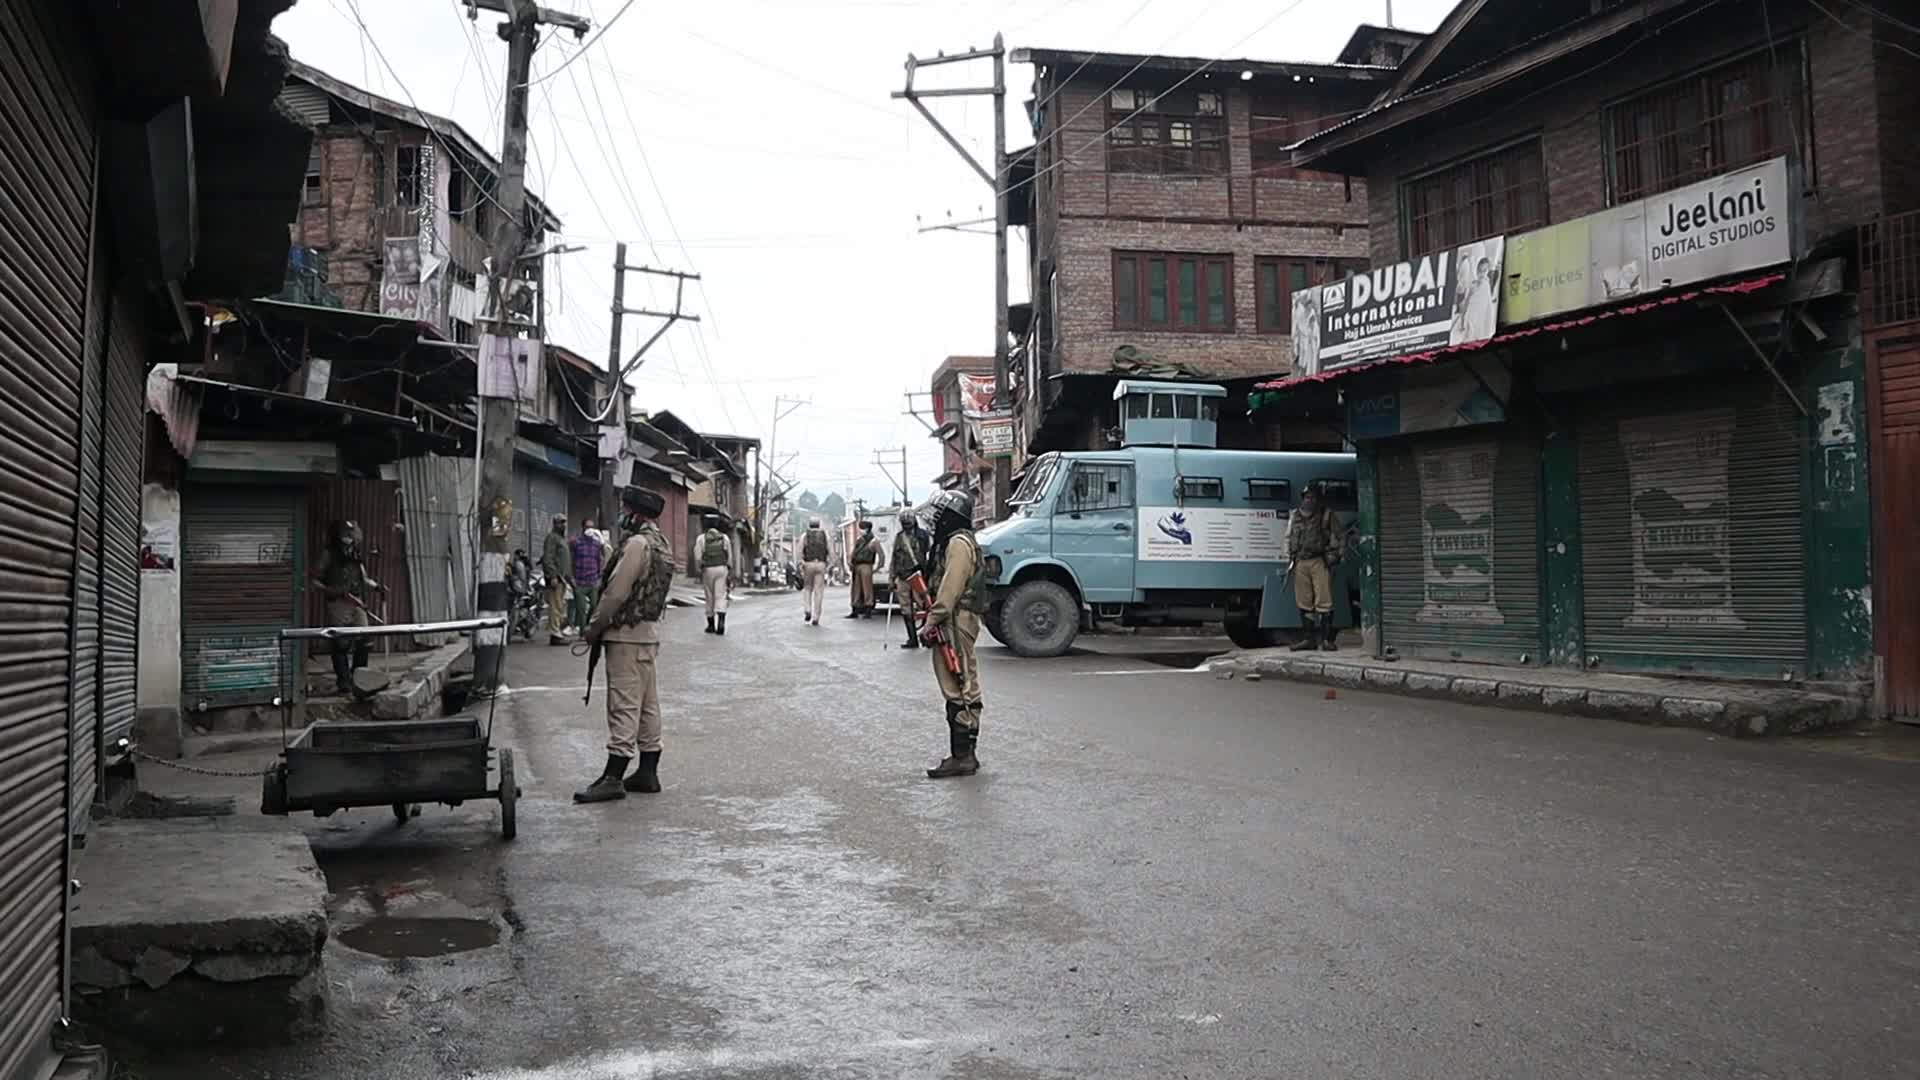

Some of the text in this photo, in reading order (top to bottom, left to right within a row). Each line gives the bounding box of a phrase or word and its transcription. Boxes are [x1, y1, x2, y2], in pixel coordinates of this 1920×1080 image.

[1661, 179, 1766, 236] Jeelani
[1652, 216, 1776, 261] DIGITAL STUDIOS
[1352, 252, 1449, 309] DUBAI
[1523, 268, 1584, 292] Services
[1328, 287, 1444, 333] International
[1367, 320, 1391, 336] Umrah
[1391, 314, 1423, 329] Services
